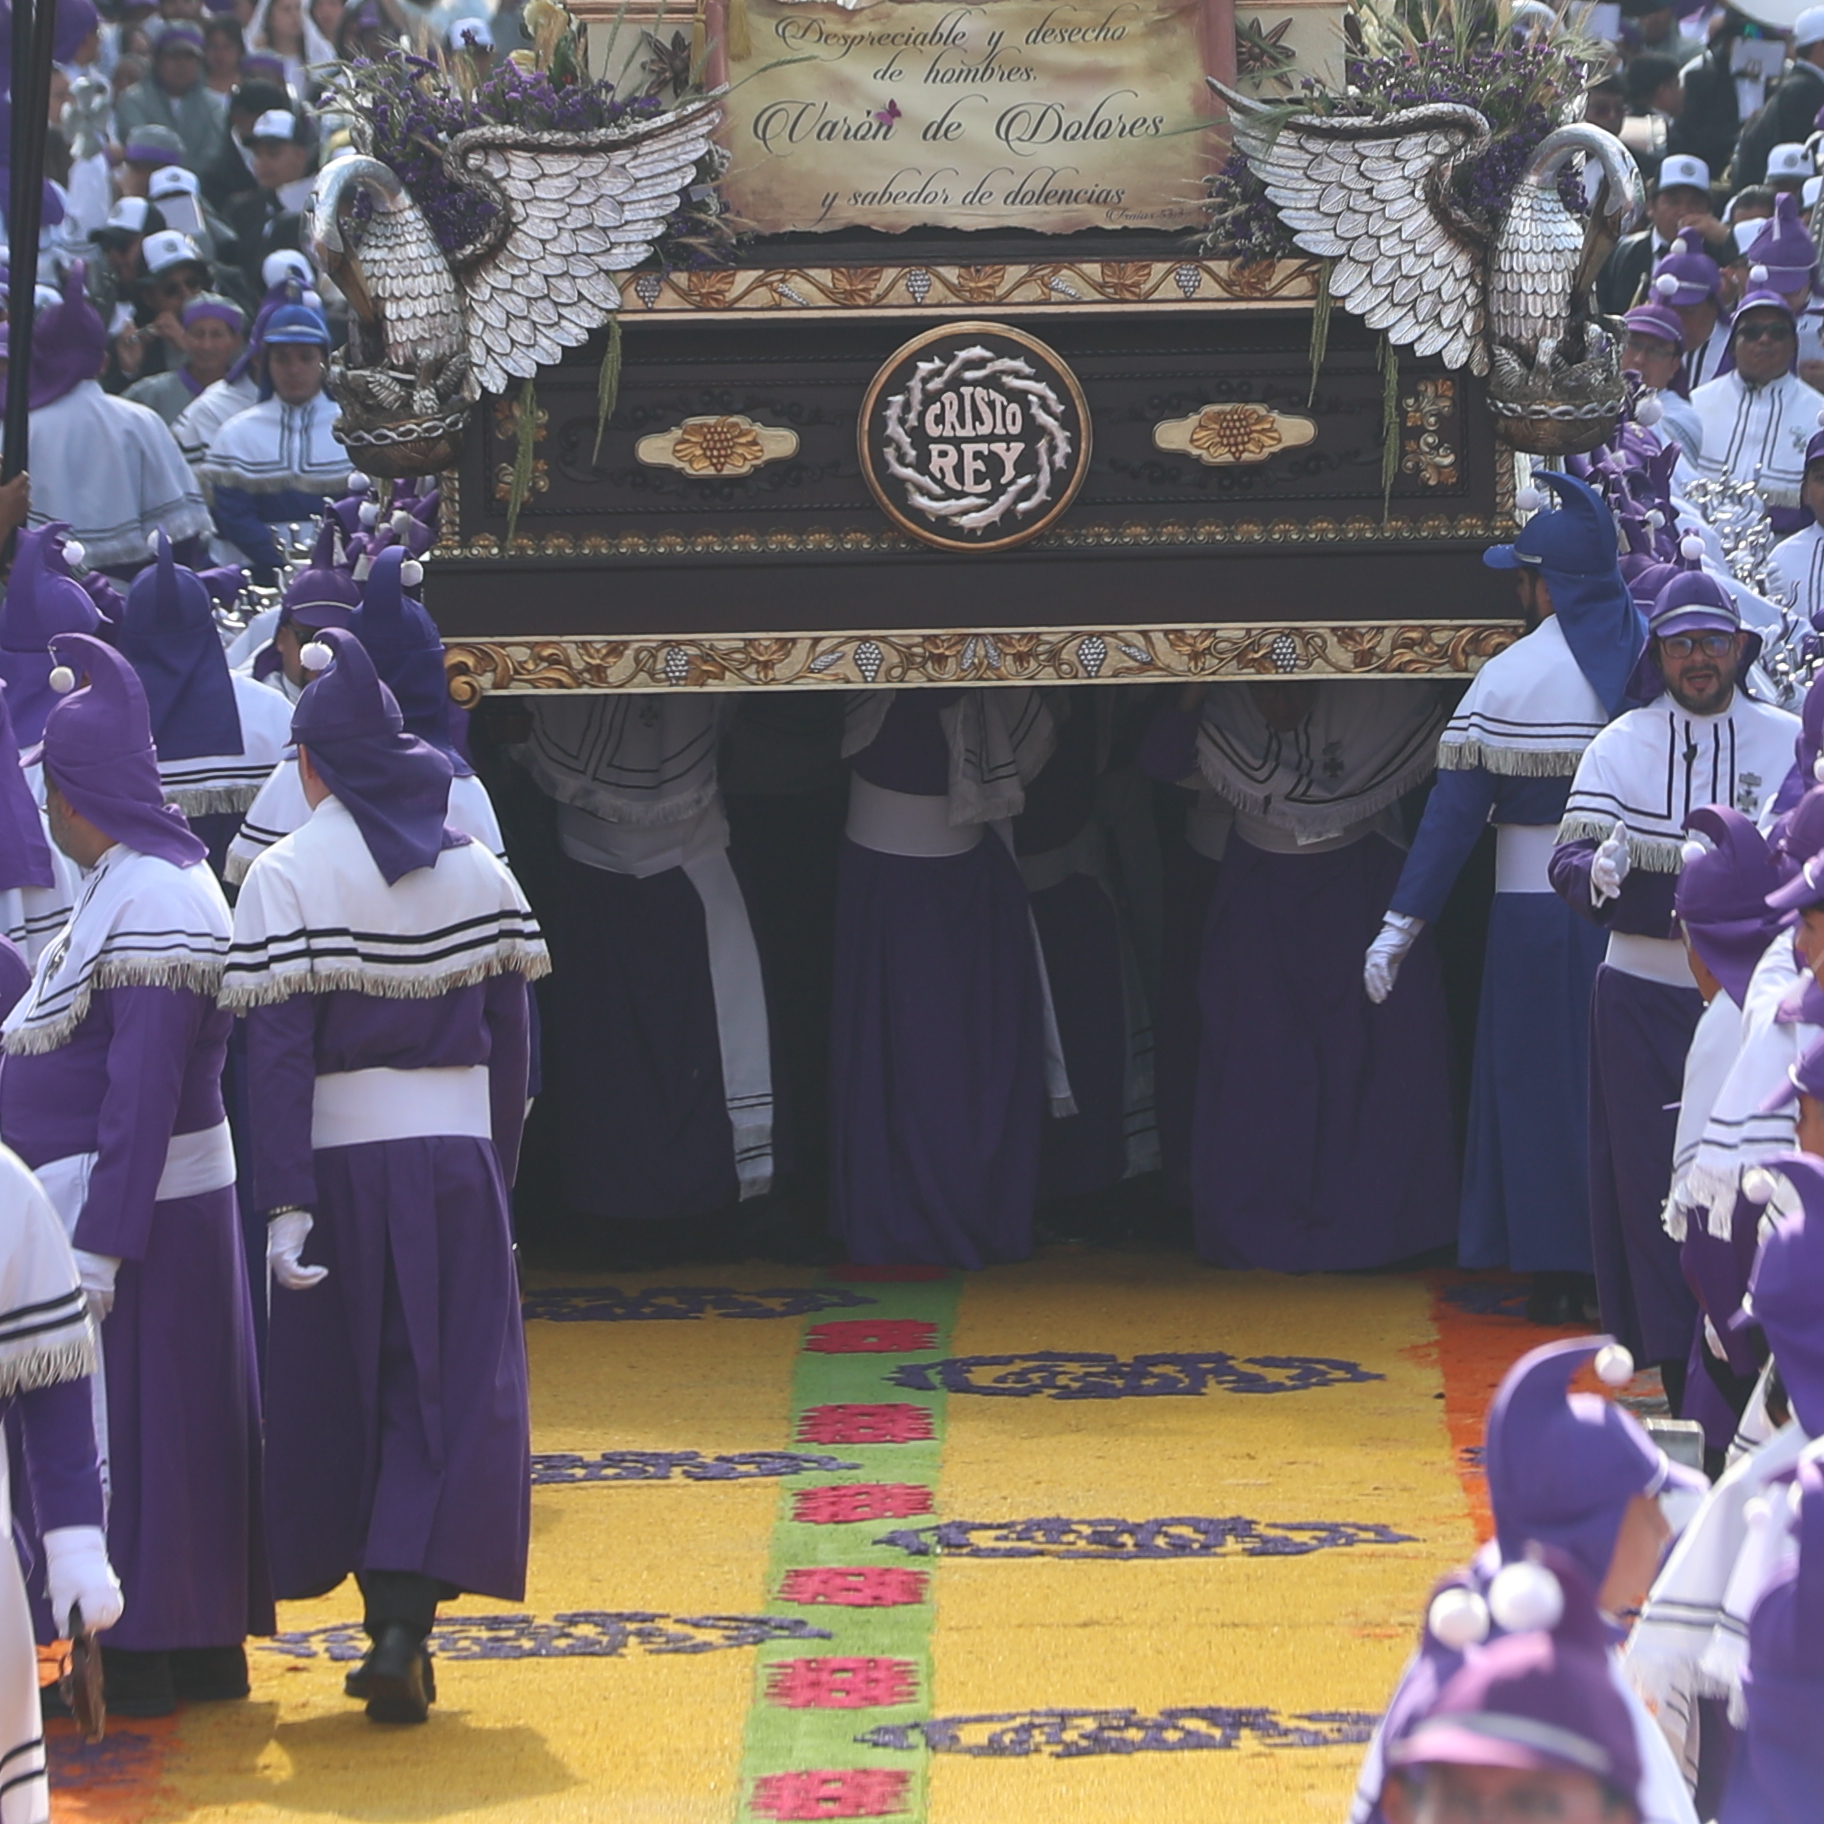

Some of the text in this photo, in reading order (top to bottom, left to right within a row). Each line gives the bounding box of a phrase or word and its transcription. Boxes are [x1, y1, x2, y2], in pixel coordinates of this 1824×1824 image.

[775, 3, 1140, 67] Despreciable y desecho
[873, 45, 1038, 84] de hombres.
[753, 88, 1165, 157] Varón de Dolores
[792, 165, 1126, 230] y sabedor de dolencias
[924, 386, 1023, 438] CRISTO
[928, 442, 1025, 494] REY
